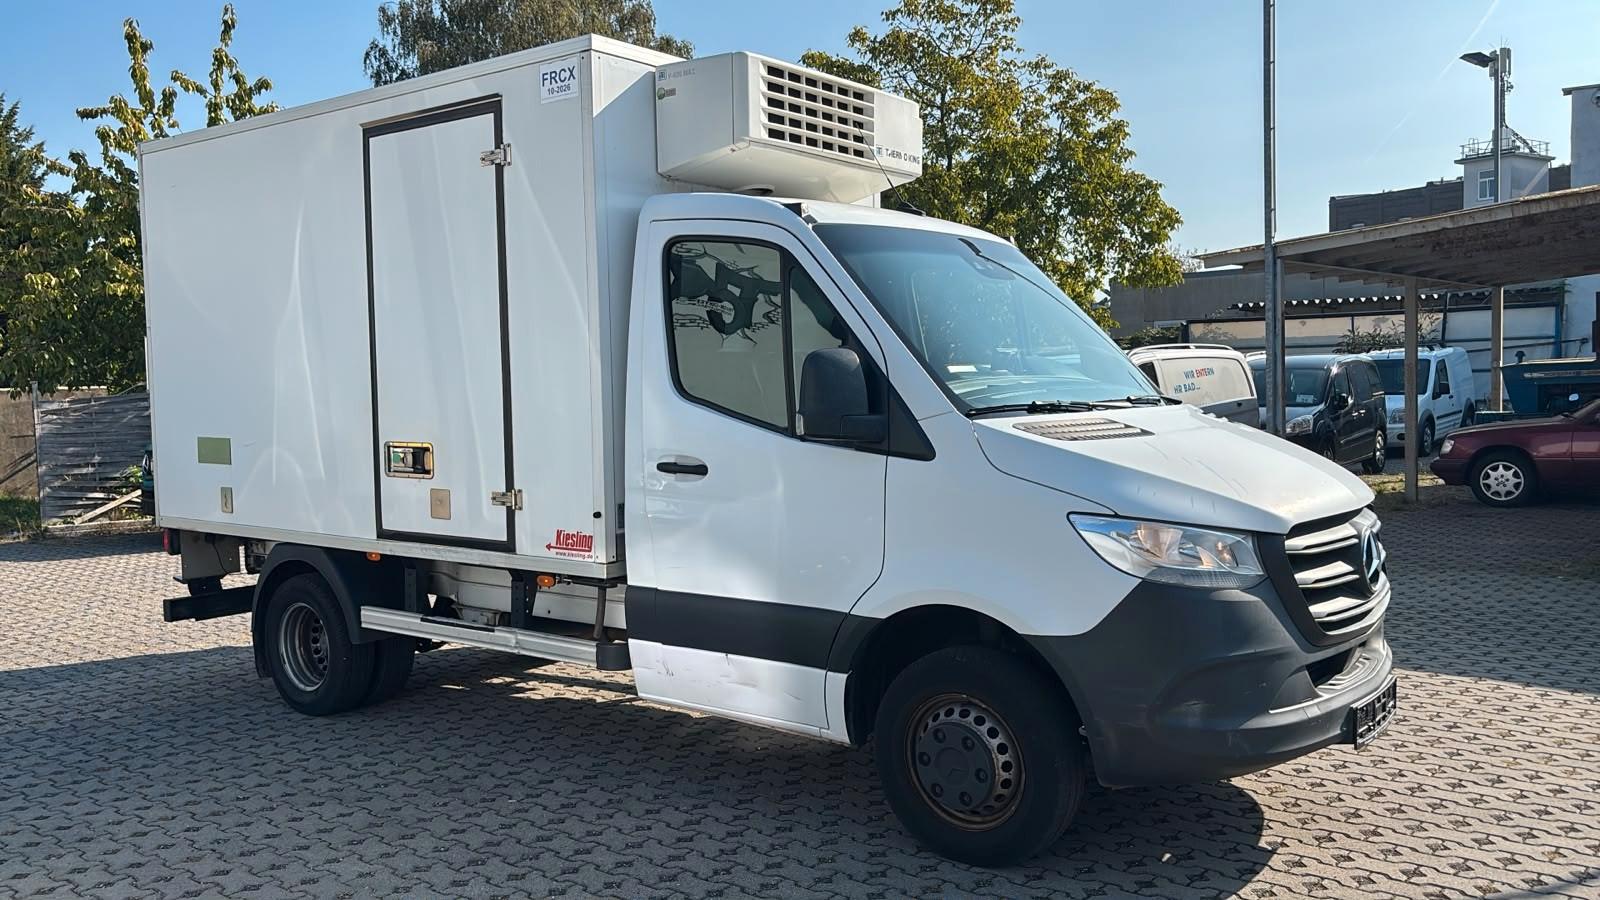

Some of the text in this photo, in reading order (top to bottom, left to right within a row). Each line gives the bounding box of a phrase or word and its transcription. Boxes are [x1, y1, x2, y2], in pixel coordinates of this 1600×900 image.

[542, 65, 576, 87] FRCX
[547, 83, 571, 96] 10-2026
[555, 529, 593, 550] Kiesling
